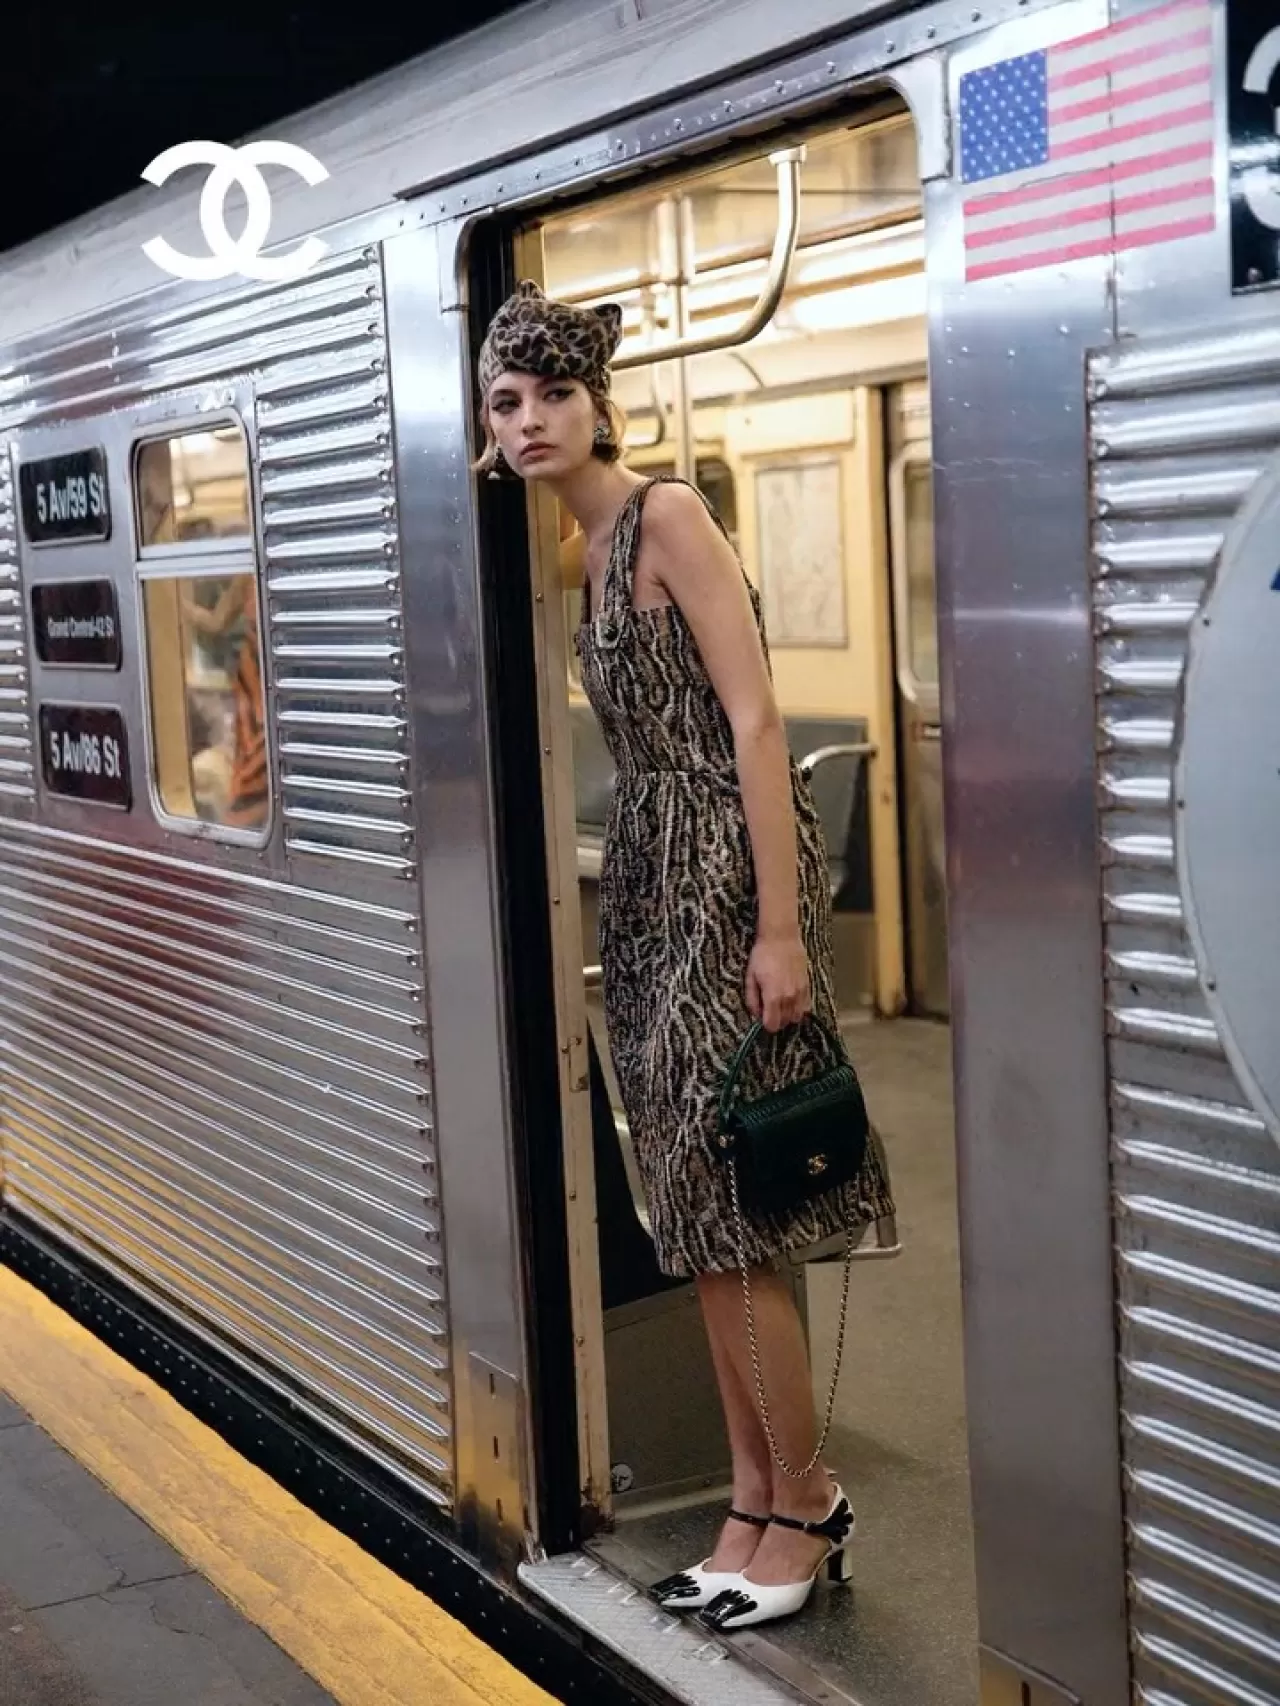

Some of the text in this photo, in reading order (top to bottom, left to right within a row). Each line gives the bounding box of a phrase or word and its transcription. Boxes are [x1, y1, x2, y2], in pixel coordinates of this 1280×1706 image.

[37, 483, 47, 524] 5
[89, 472, 107, 516] St
[50, 731, 60, 770] 5
[103, 735, 121, 778] St
